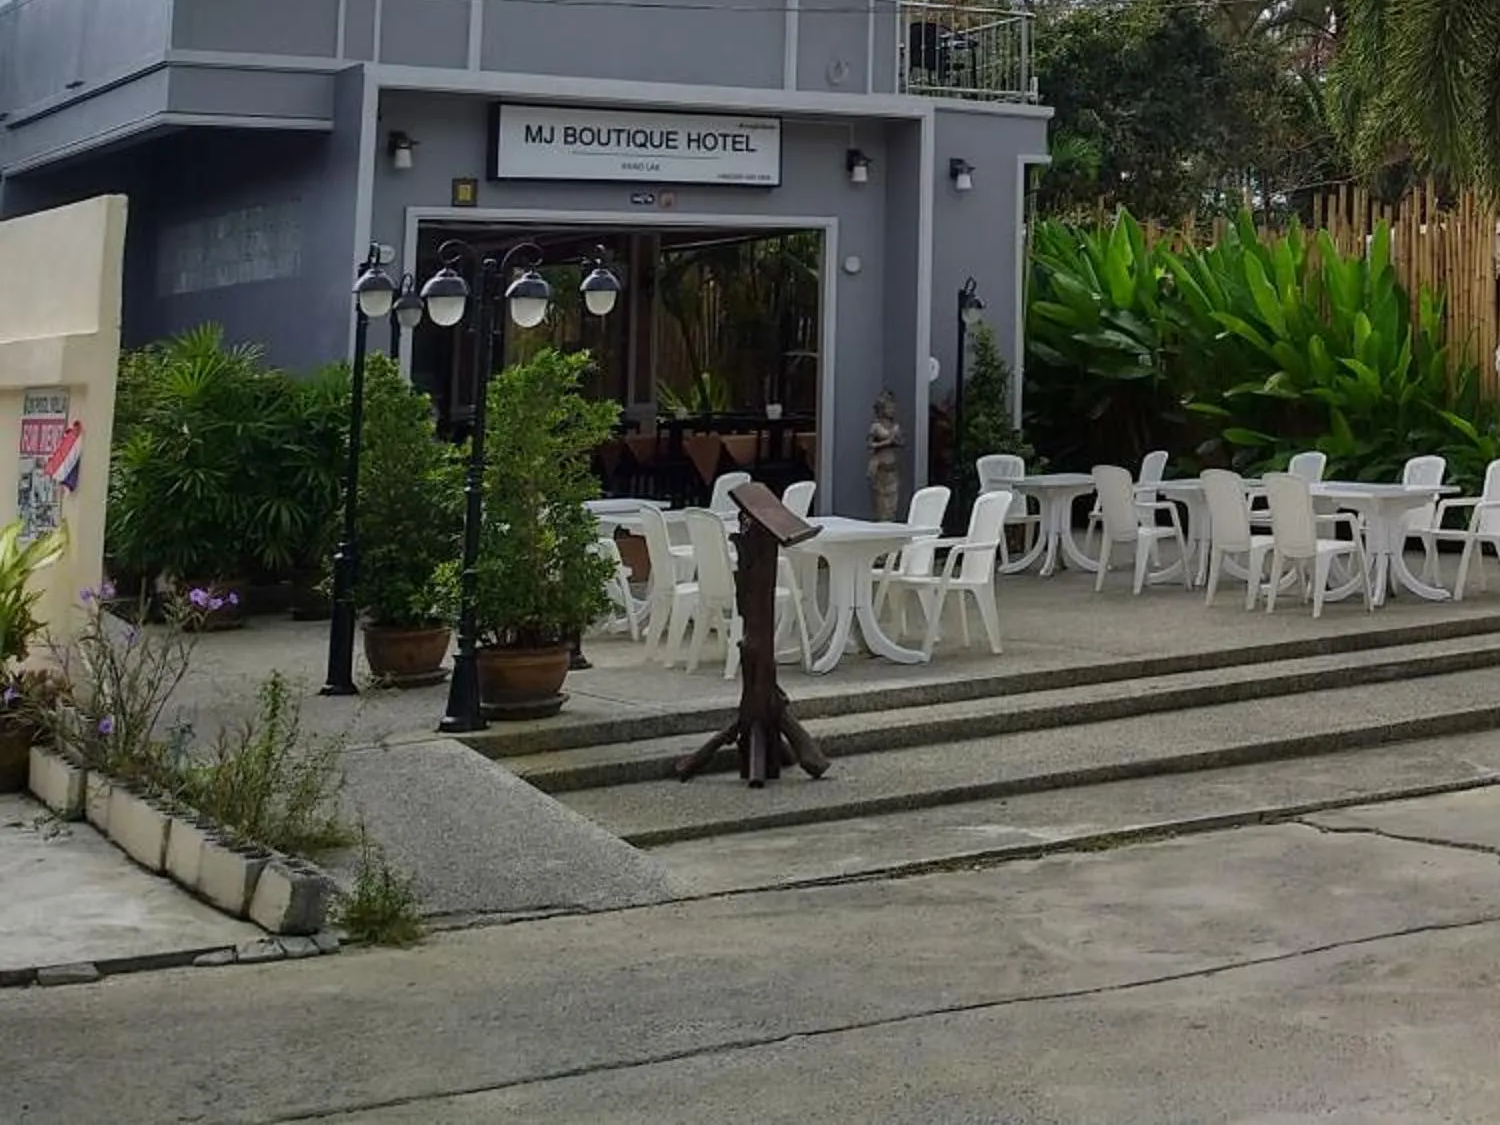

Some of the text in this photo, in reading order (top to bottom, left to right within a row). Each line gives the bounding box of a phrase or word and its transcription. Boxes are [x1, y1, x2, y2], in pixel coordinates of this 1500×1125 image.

[524, 124, 758, 153] MJ BOUTIQUE HOTEL
